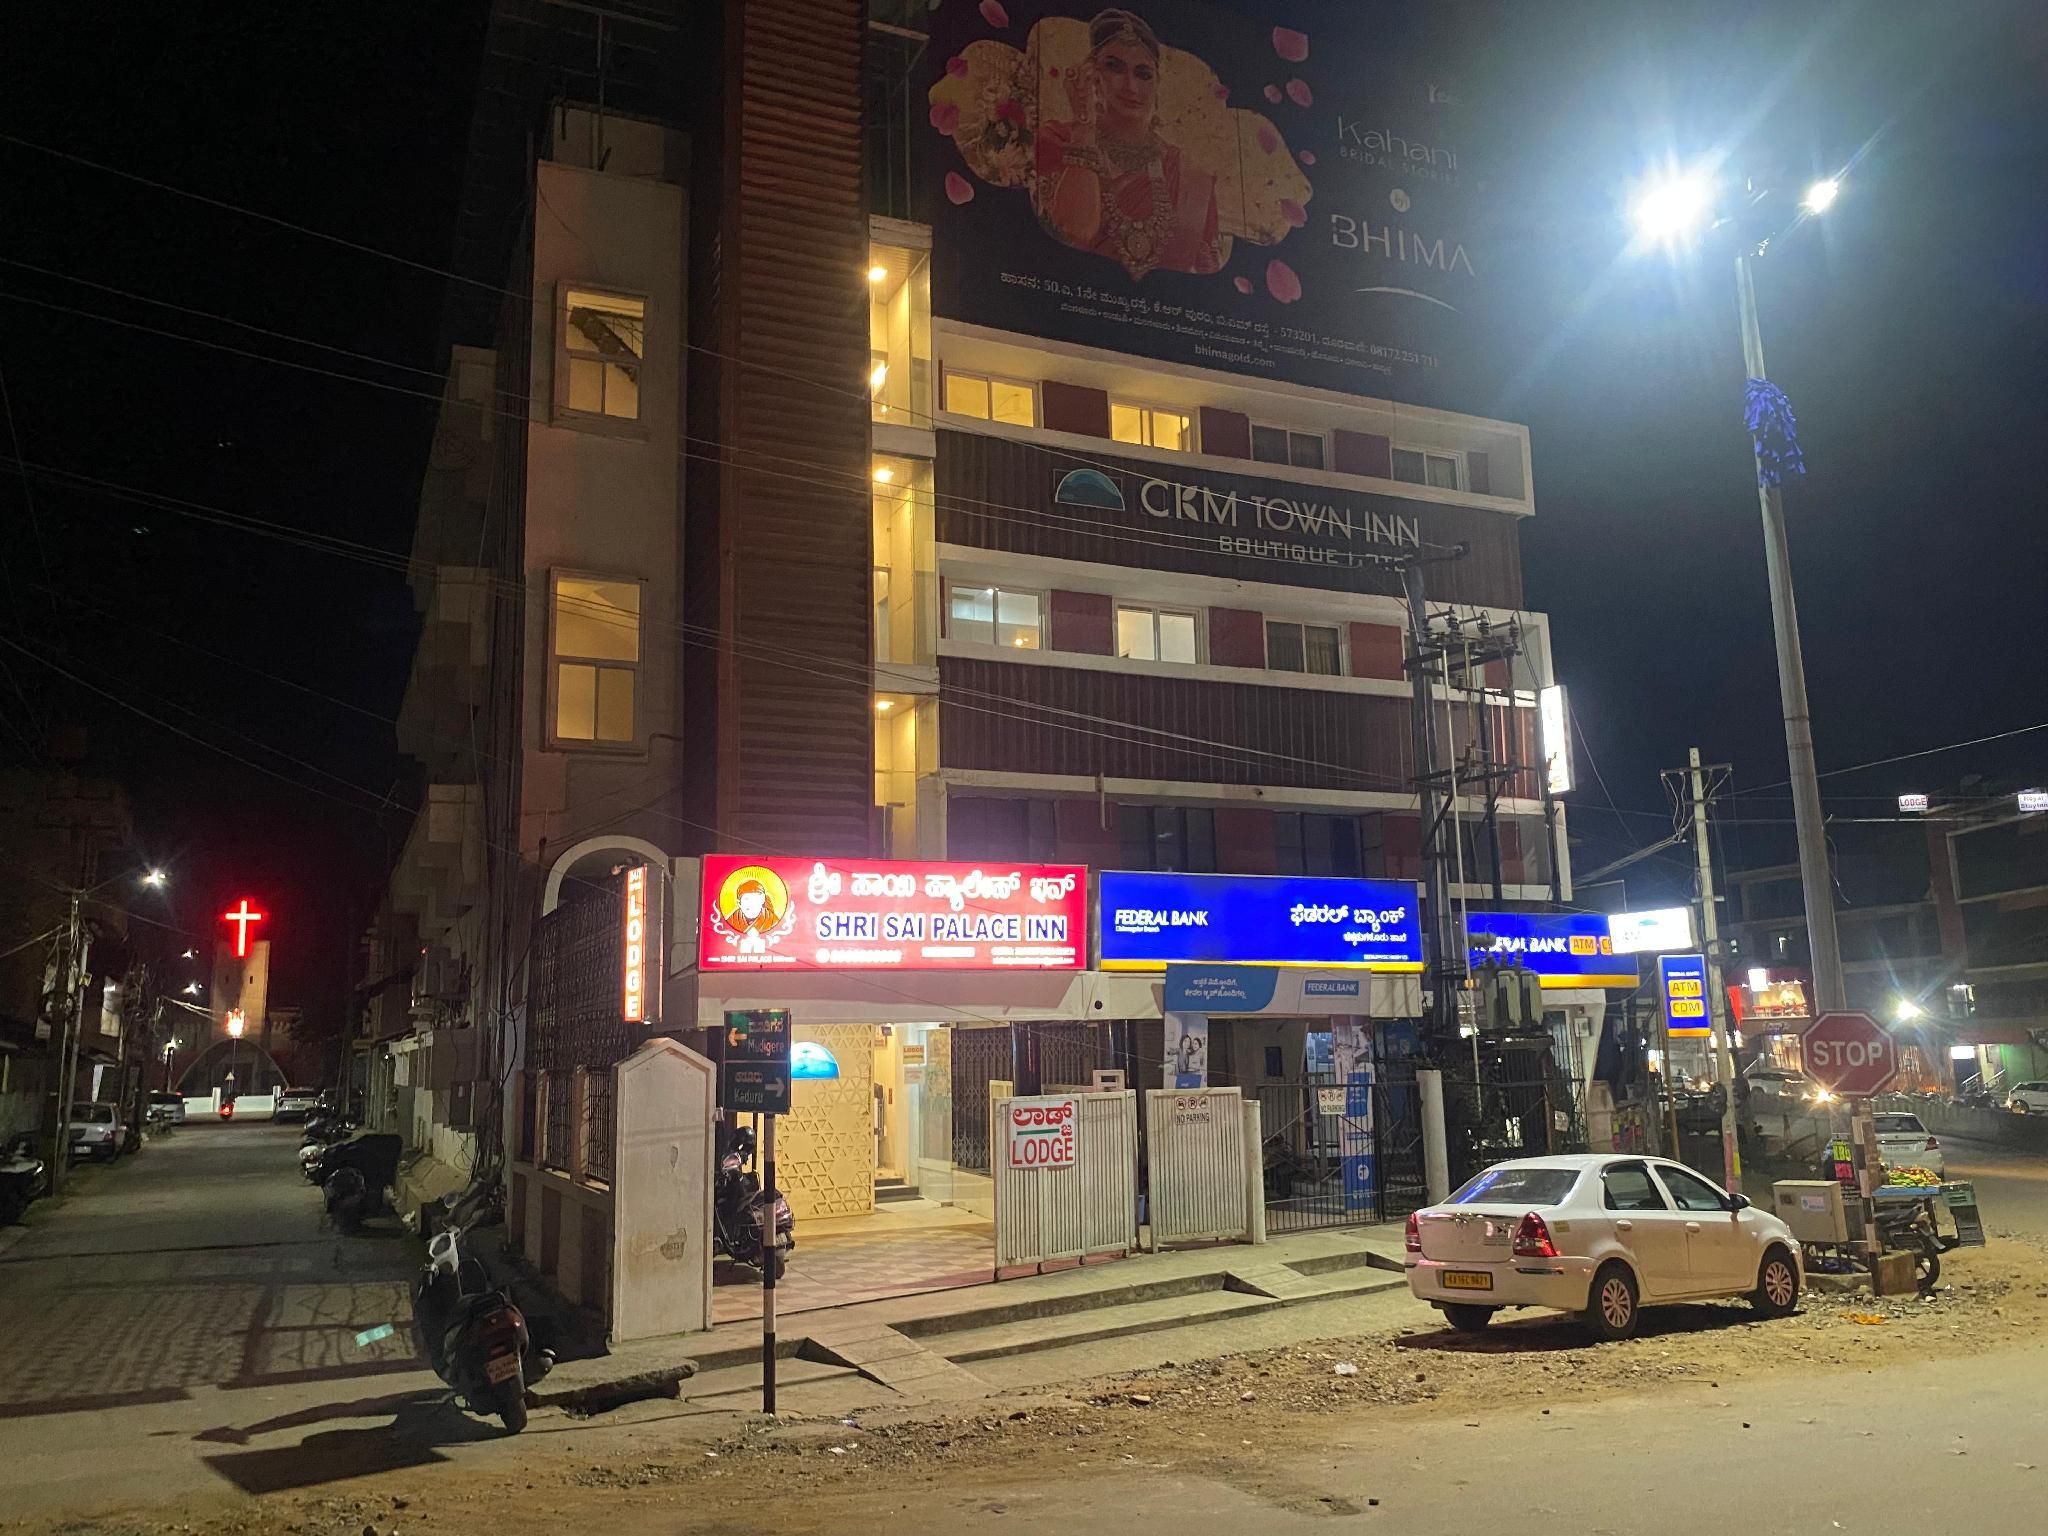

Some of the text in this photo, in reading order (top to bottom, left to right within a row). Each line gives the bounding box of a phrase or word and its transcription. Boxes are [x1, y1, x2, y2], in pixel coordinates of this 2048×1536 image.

[1338, 115, 1457, 170] Kahani
[1340, 146, 1391, 168] BRIDAL
[1331, 214, 1477, 278] BHIMA
[1195, 344, 1275, 368] bhimagold.com
[1140, 479, 1420, 548] CKM TOWN INN
[1220, 536, 1338, 564] BOUTIQUE
[1900, 798, 1926, 806] LODGE
[808, 862, 842, 904] ಶ್ರೀ
[1030, 874, 1076, 903] ಇನ್
[818, 915, 1066, 940] SHRI SAI PALACE INN
[1115, 910, 1208, 925] FEDERAL BANK
[1290, 903, 1405, 932] ಫೆಡರಲ್ ಬ್ಯಾಂಕ್
[627, 894, 641, 1017] LODGE
[1530, 937, 1567, 952] BANK
[1573, 938, 1594, 949] ATM
[1307, 982, 1356, 992] FEDERAL BANK
[1673, 982, 1698, 992] ATM
[1673, 1003, 1700, 1013] CDM
[748, 1039, 784, 1056] Mudigere
[1813, 1041, 1883, 1066] STOP
[1176, 1112, 1209, 1123] NO PARKING
[1013, 1138, 1073, 1164] LODGE
